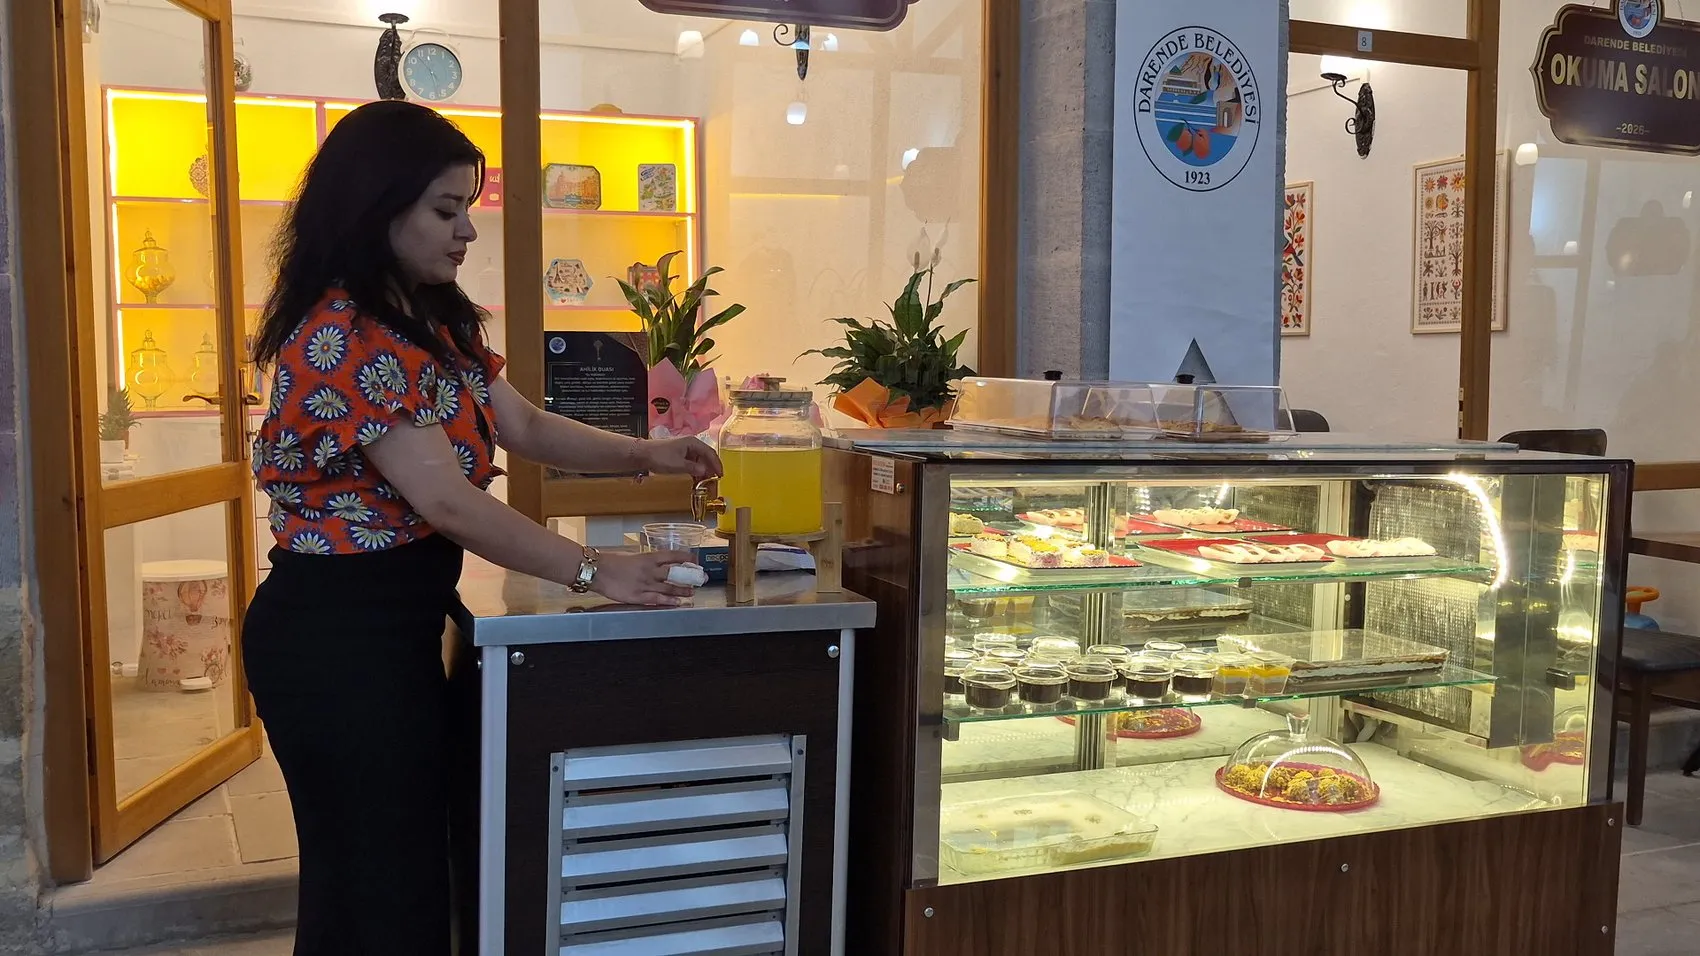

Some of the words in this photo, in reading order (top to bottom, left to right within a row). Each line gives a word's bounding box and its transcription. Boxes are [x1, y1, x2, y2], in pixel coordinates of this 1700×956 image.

[1362, 36, 1366, 46] 8
[1584, 35, 1630, 50] DARENDE
[417, 49, 424, 57] 11
[427, 47, 437, 56] 12
[449, 60, 454, 68] 2
[452, 72, 458, 80] 3
[1550, 53, 1628, 92] OKUMA
[1138, 34, 1189, 114] DARENDE
[1194, 33, 1259, 125] BELEDİYESİ
[429, 92, 435, 100] 6
[440, 89, 447, 97] 5
[1184, 170, 1211, 185] 1923
